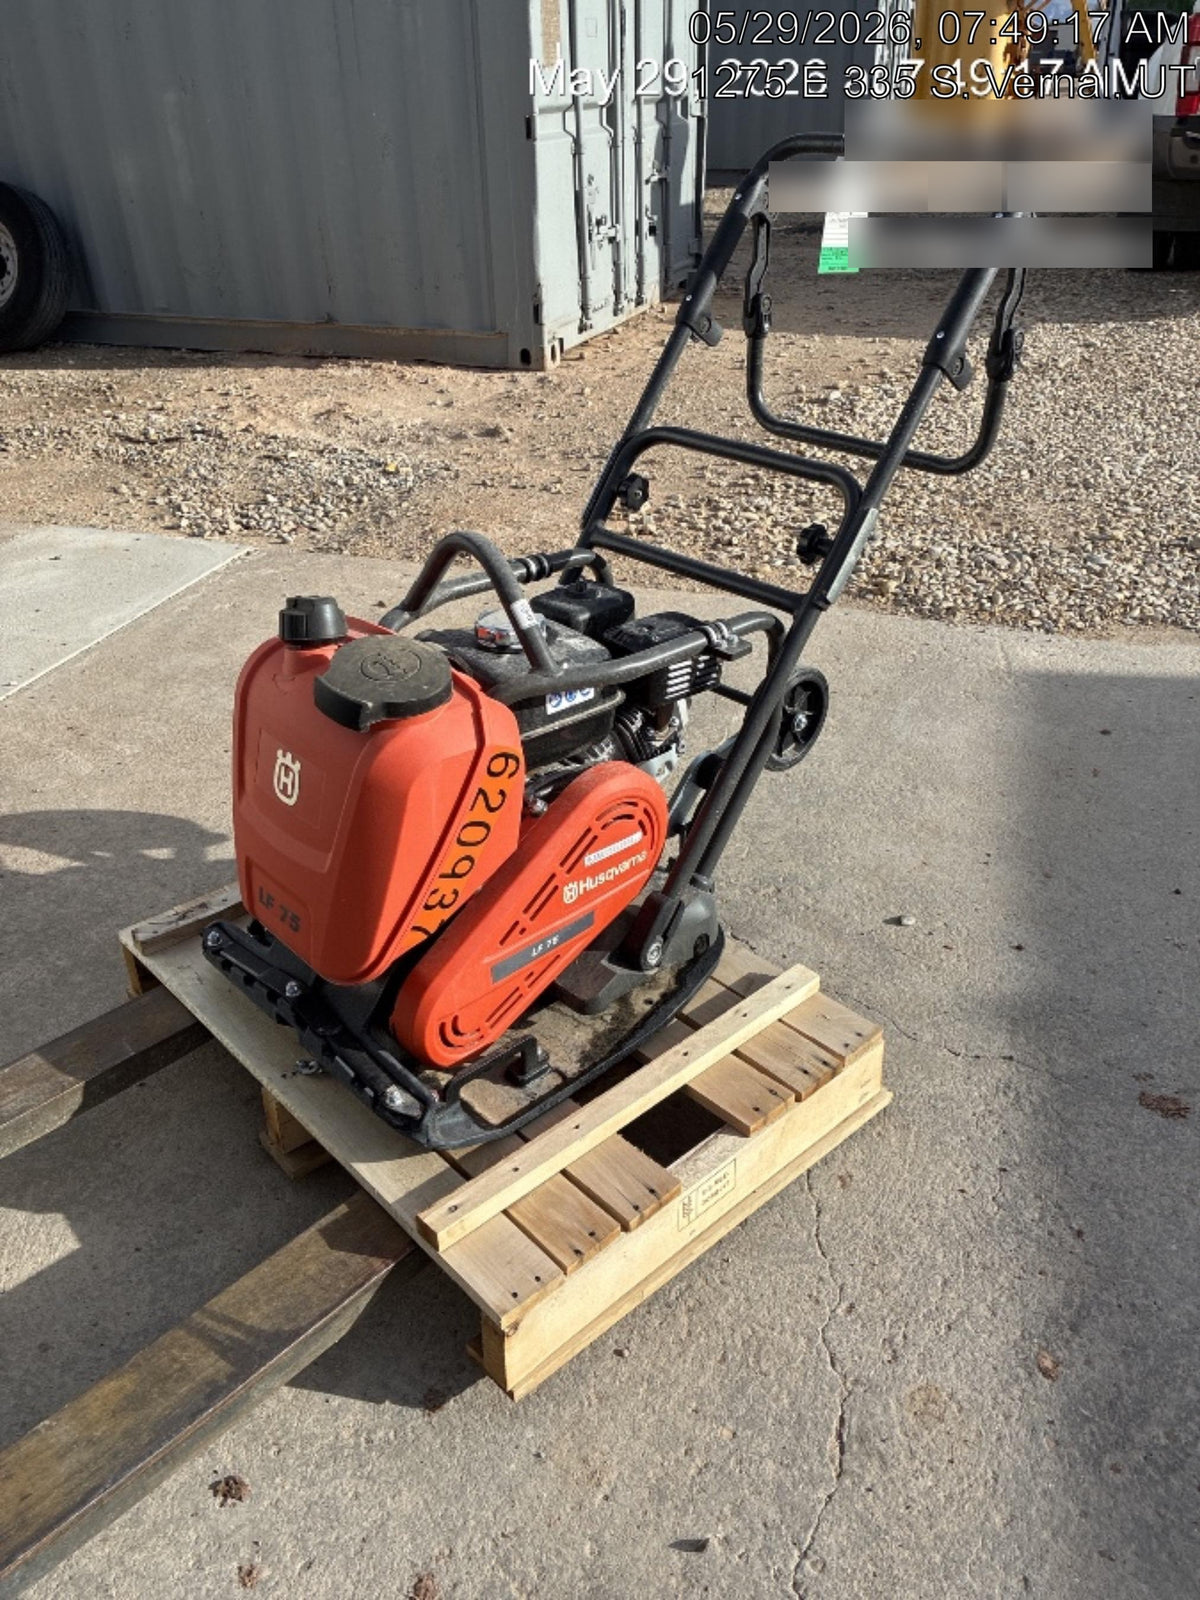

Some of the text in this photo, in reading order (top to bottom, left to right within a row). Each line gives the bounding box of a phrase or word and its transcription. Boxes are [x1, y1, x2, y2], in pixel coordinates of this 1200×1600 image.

[579, 850, 648, 895] Husqvarna
[258, 885, 301, 933] LF 75
[531, 943, 543, 957] LF
